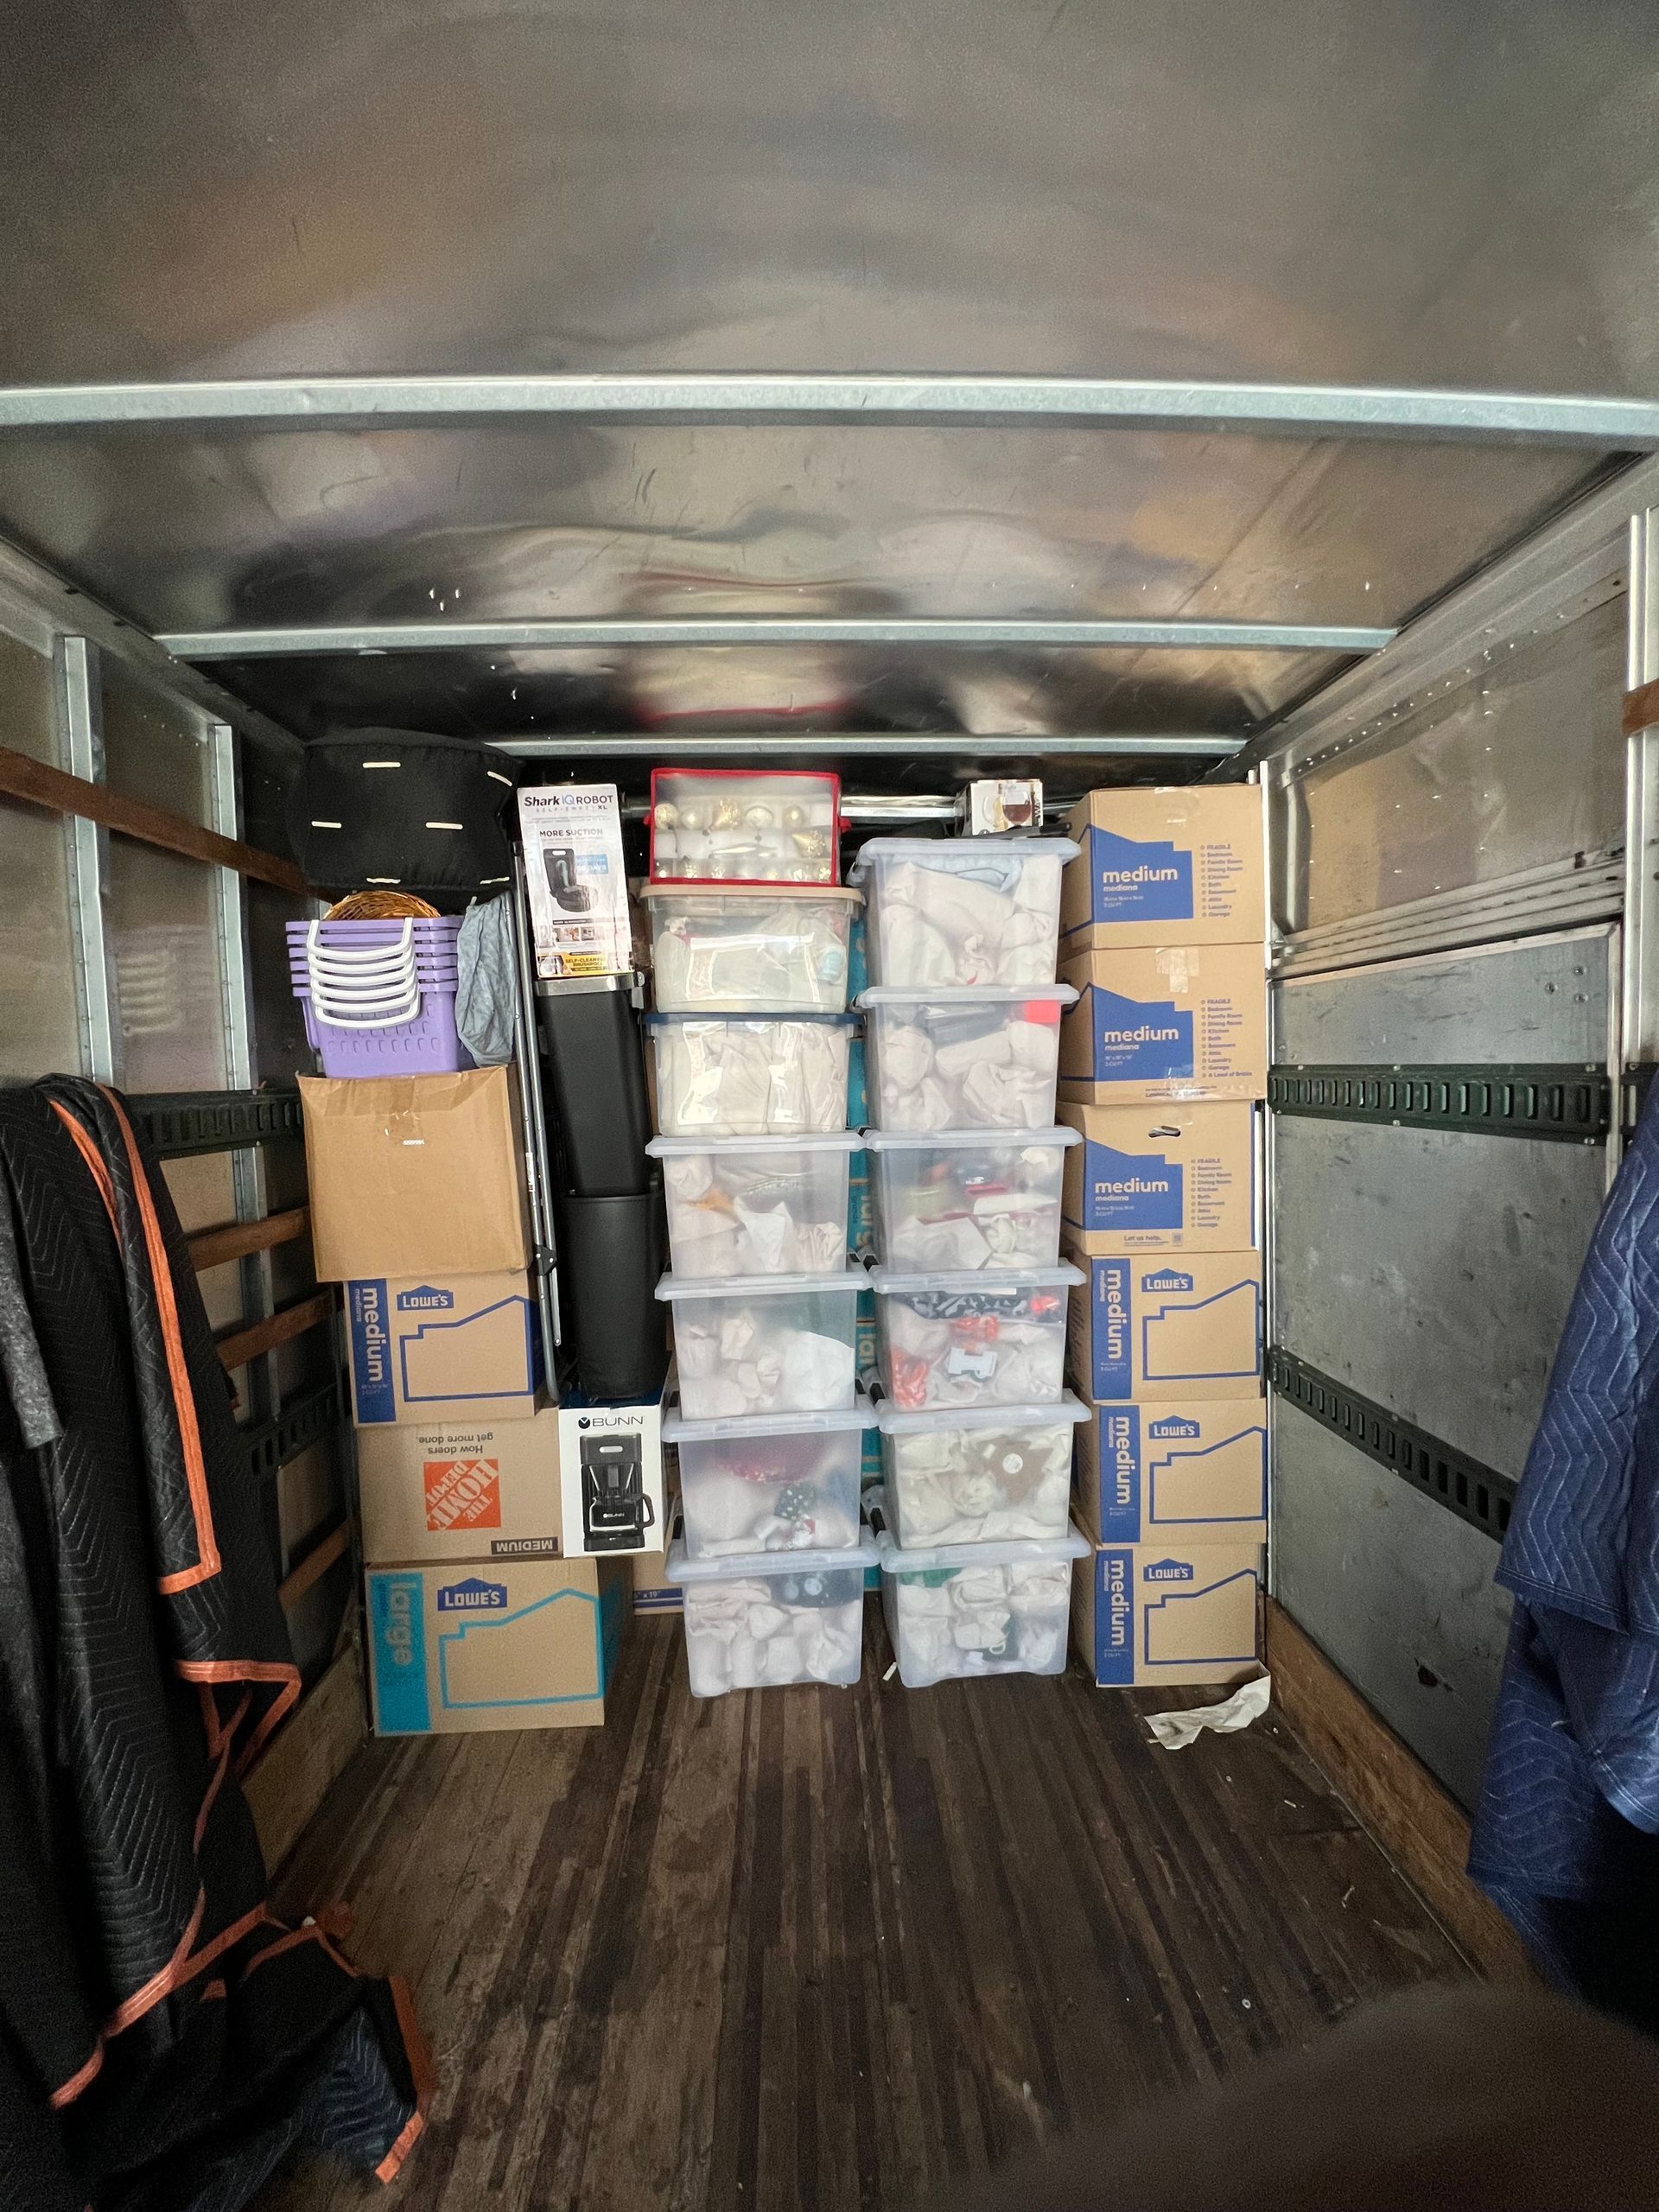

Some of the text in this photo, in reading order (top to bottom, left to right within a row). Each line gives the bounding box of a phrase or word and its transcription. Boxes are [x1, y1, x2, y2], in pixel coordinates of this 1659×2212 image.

[524, 794, 613, 807] Shark IQ ROBOT
[566, 828, 603, 836] SUCTION
[1103, 866, 1178, 883] medium
[1104, 1026, 1179, 1042] medium
[1095, 1178, 1168, 1193] medium
[1147, 1276, 1188, 1290] LOWE'S
[403, 1294, 448, 1308] LOWE'S
[1107, 1269, 1128, 1359] medium
[362, 1287, 387, 1382] medium
[593, 1416, 644, 1427] BUNN
[477, 1432, 493, 1440] get
[1154, 1423, 1195, 1437] LOWE'S
[416, 1436, 444, 1445] done.
[460, 1445, 483, 1453] How
[1116, 1416, 1135, 1504] medium
[426, 1461, 469, 1506] DEPOT
[427, 1459, 499, 1530] HOME
[463, 1494, 493, 1522] THE
[496, 1538, 553, 1553] MEDIUM
[1148, 1567, 1189, 1580] LOWE'S
[444, 1590, 501, 1607] LOWE'S
[1110, 1560, 1130, 1646] medium
[385, 1582, 416, 1665] large
